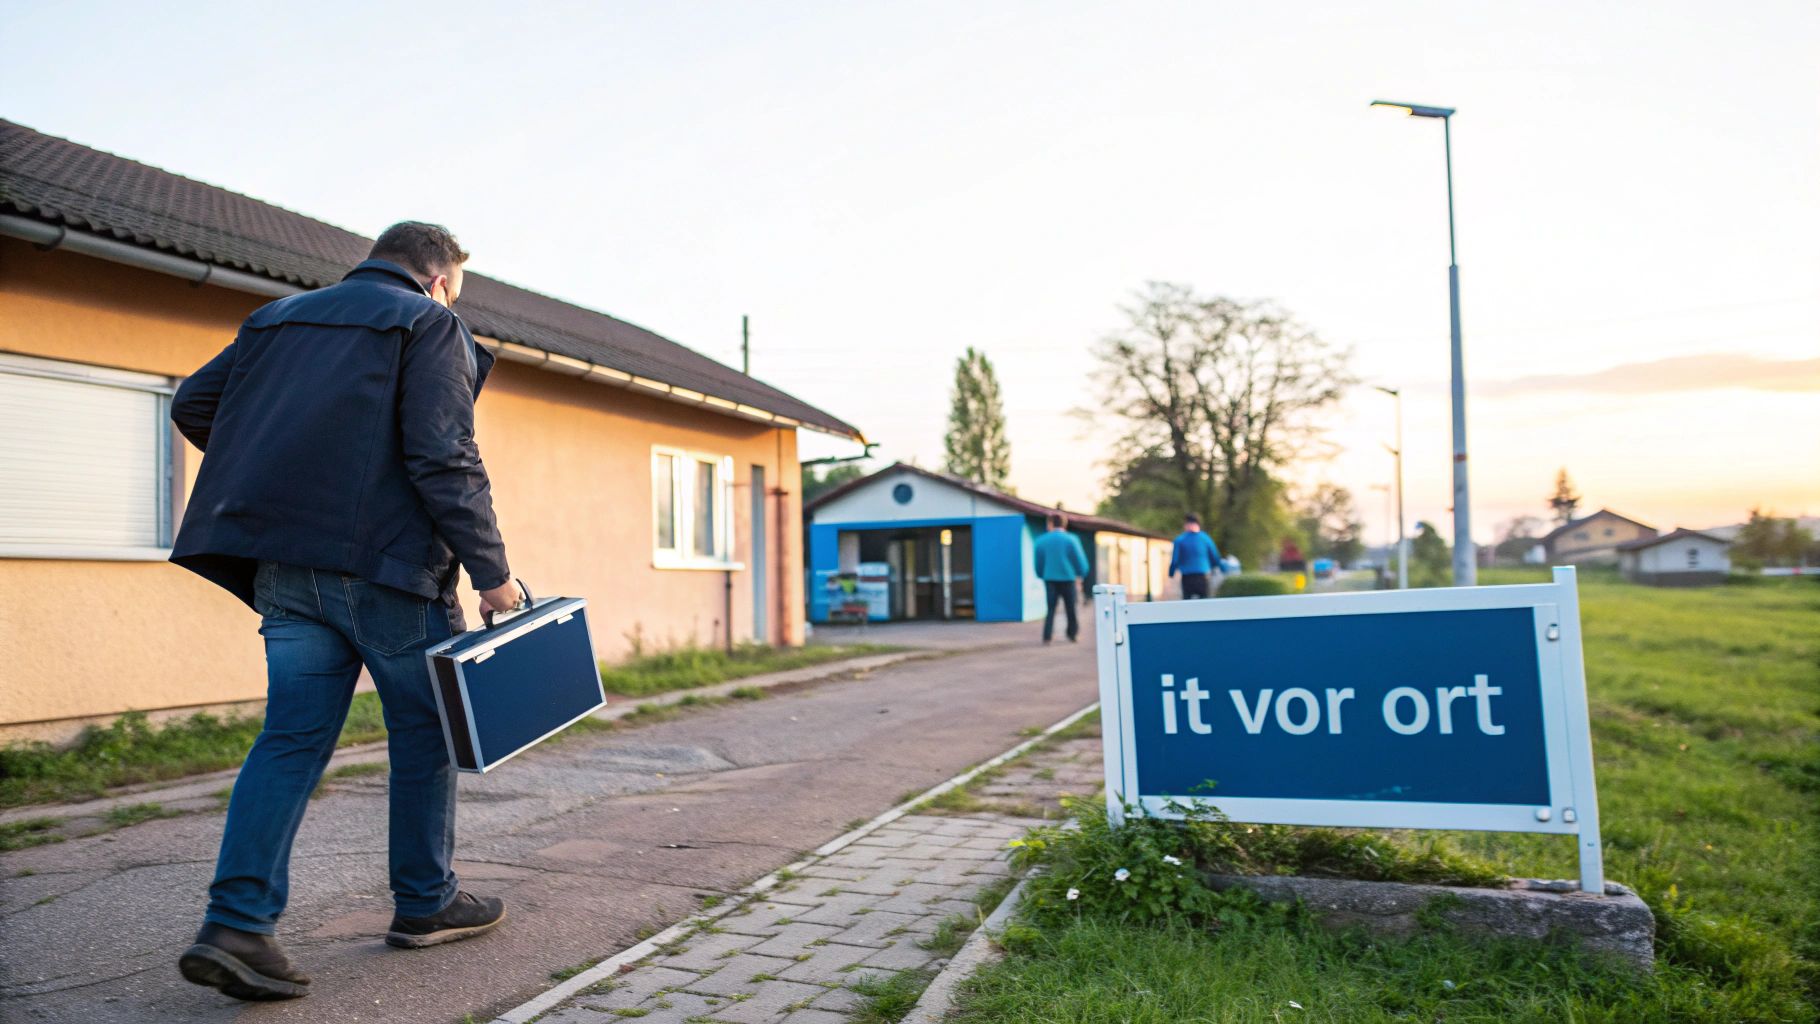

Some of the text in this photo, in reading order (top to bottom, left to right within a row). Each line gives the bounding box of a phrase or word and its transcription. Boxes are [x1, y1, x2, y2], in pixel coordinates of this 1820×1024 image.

[1161, 673, 1505, 736] it vor ort
